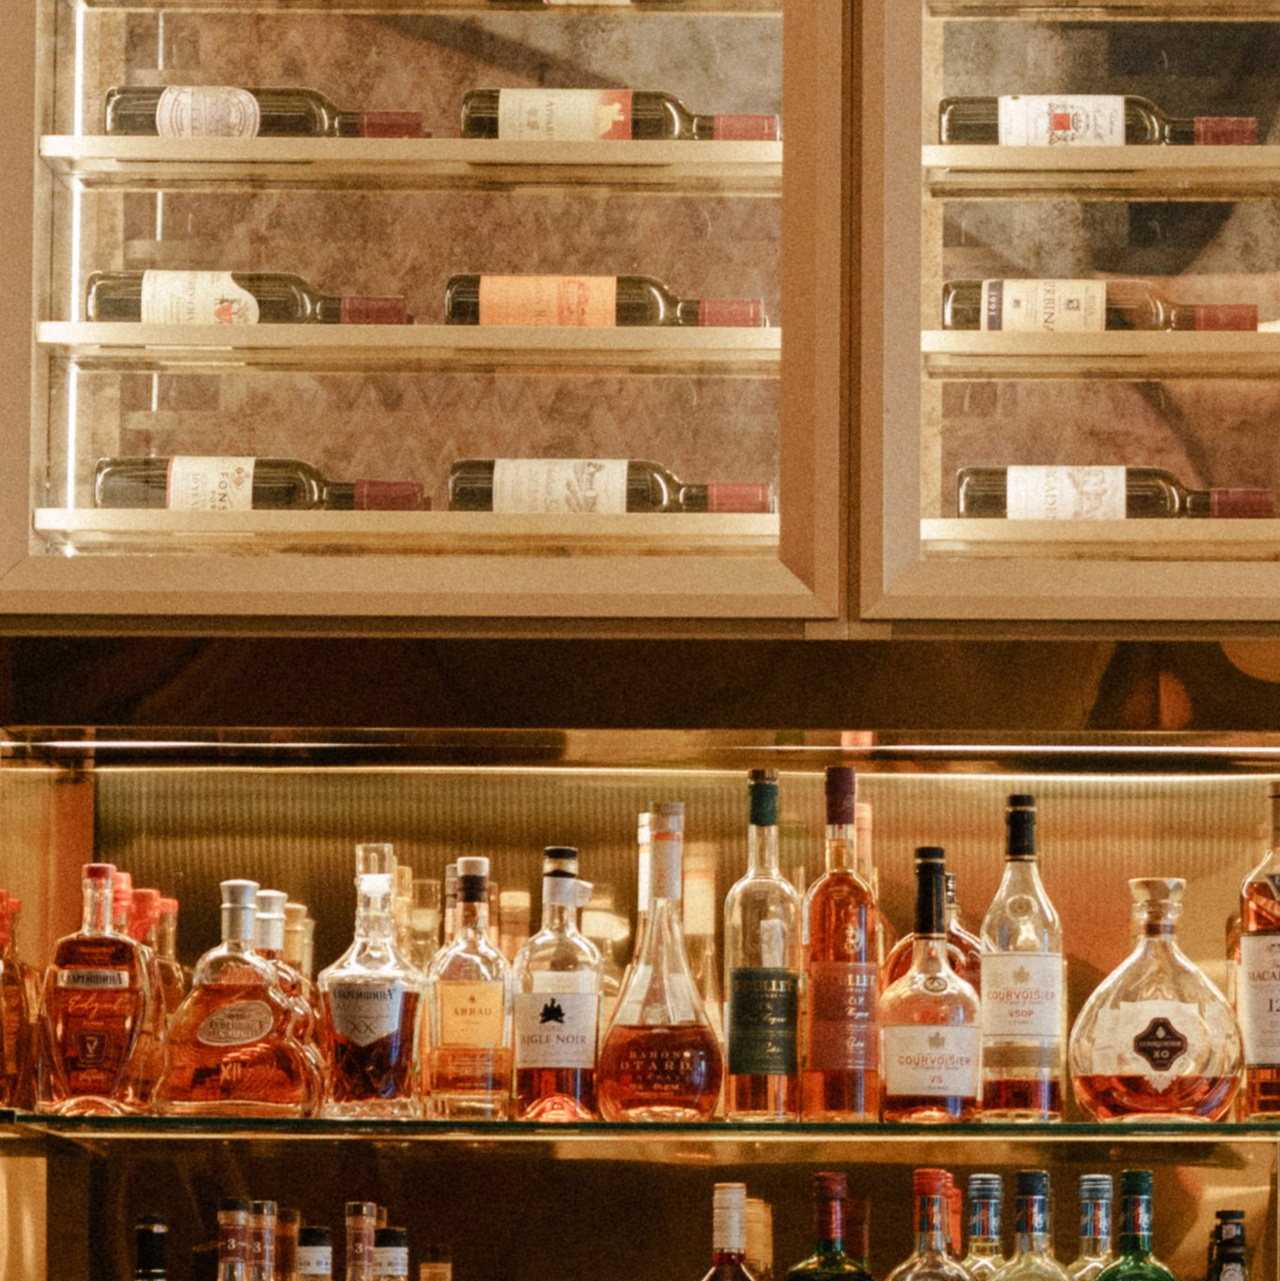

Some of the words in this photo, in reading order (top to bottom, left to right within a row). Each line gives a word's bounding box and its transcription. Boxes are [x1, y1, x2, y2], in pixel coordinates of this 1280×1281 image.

[987, 990, 1055, 1001] COURVOISIER
[347, 1022, 373, 1035] XX
[555, 1033, 587, 1045] NOIR
[1153, 1050, 1170, 1059] XO
[898, 1055, 972, 1067] COURVOISIER
